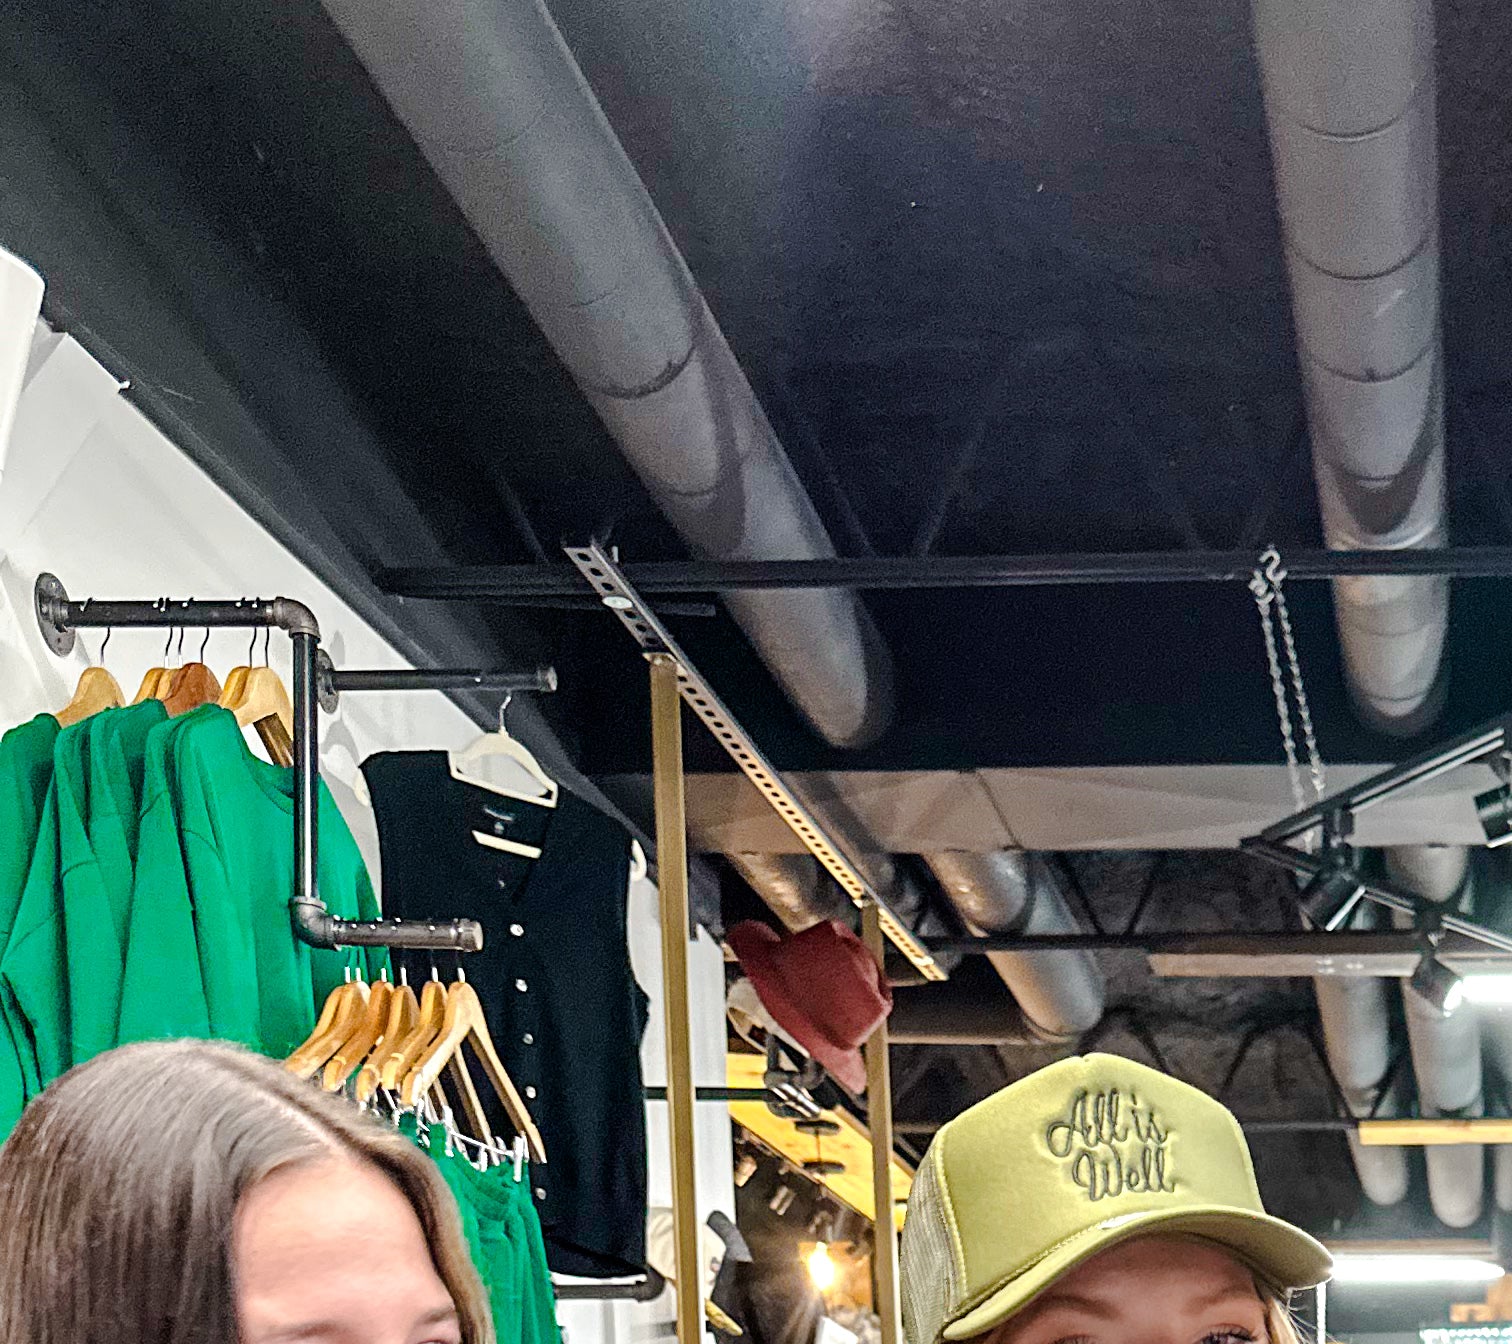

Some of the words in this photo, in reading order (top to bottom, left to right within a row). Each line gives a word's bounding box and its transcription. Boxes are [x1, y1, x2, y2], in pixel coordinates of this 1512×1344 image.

[1047, 1087, 1128, 1157] All
[1130, 1093, 1169, 1144] is
[1072, 1145, 1176, 1201] Well
